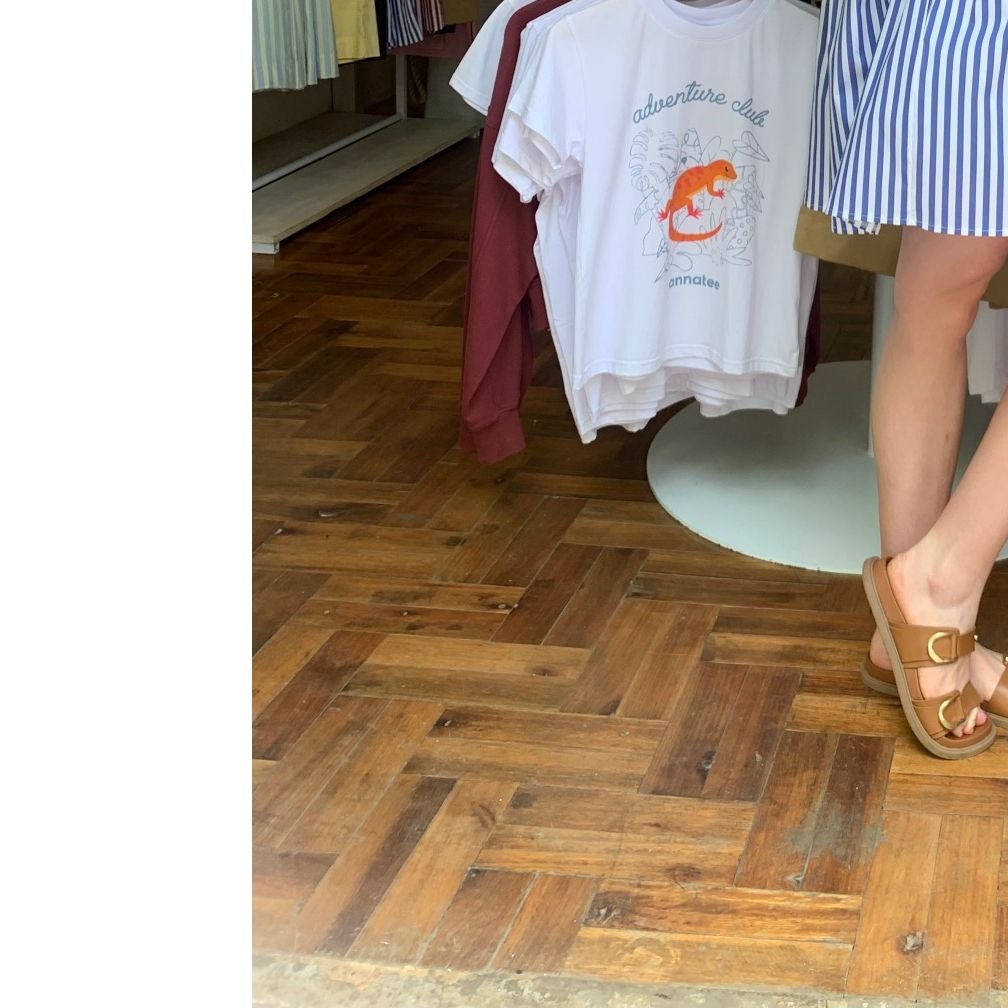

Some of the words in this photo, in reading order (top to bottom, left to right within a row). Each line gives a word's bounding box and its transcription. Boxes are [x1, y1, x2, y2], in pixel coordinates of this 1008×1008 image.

[633, 80, 727, 124] adventure
[731, 97, 769, 128] club
[668, 274, 720, 290] annatee
